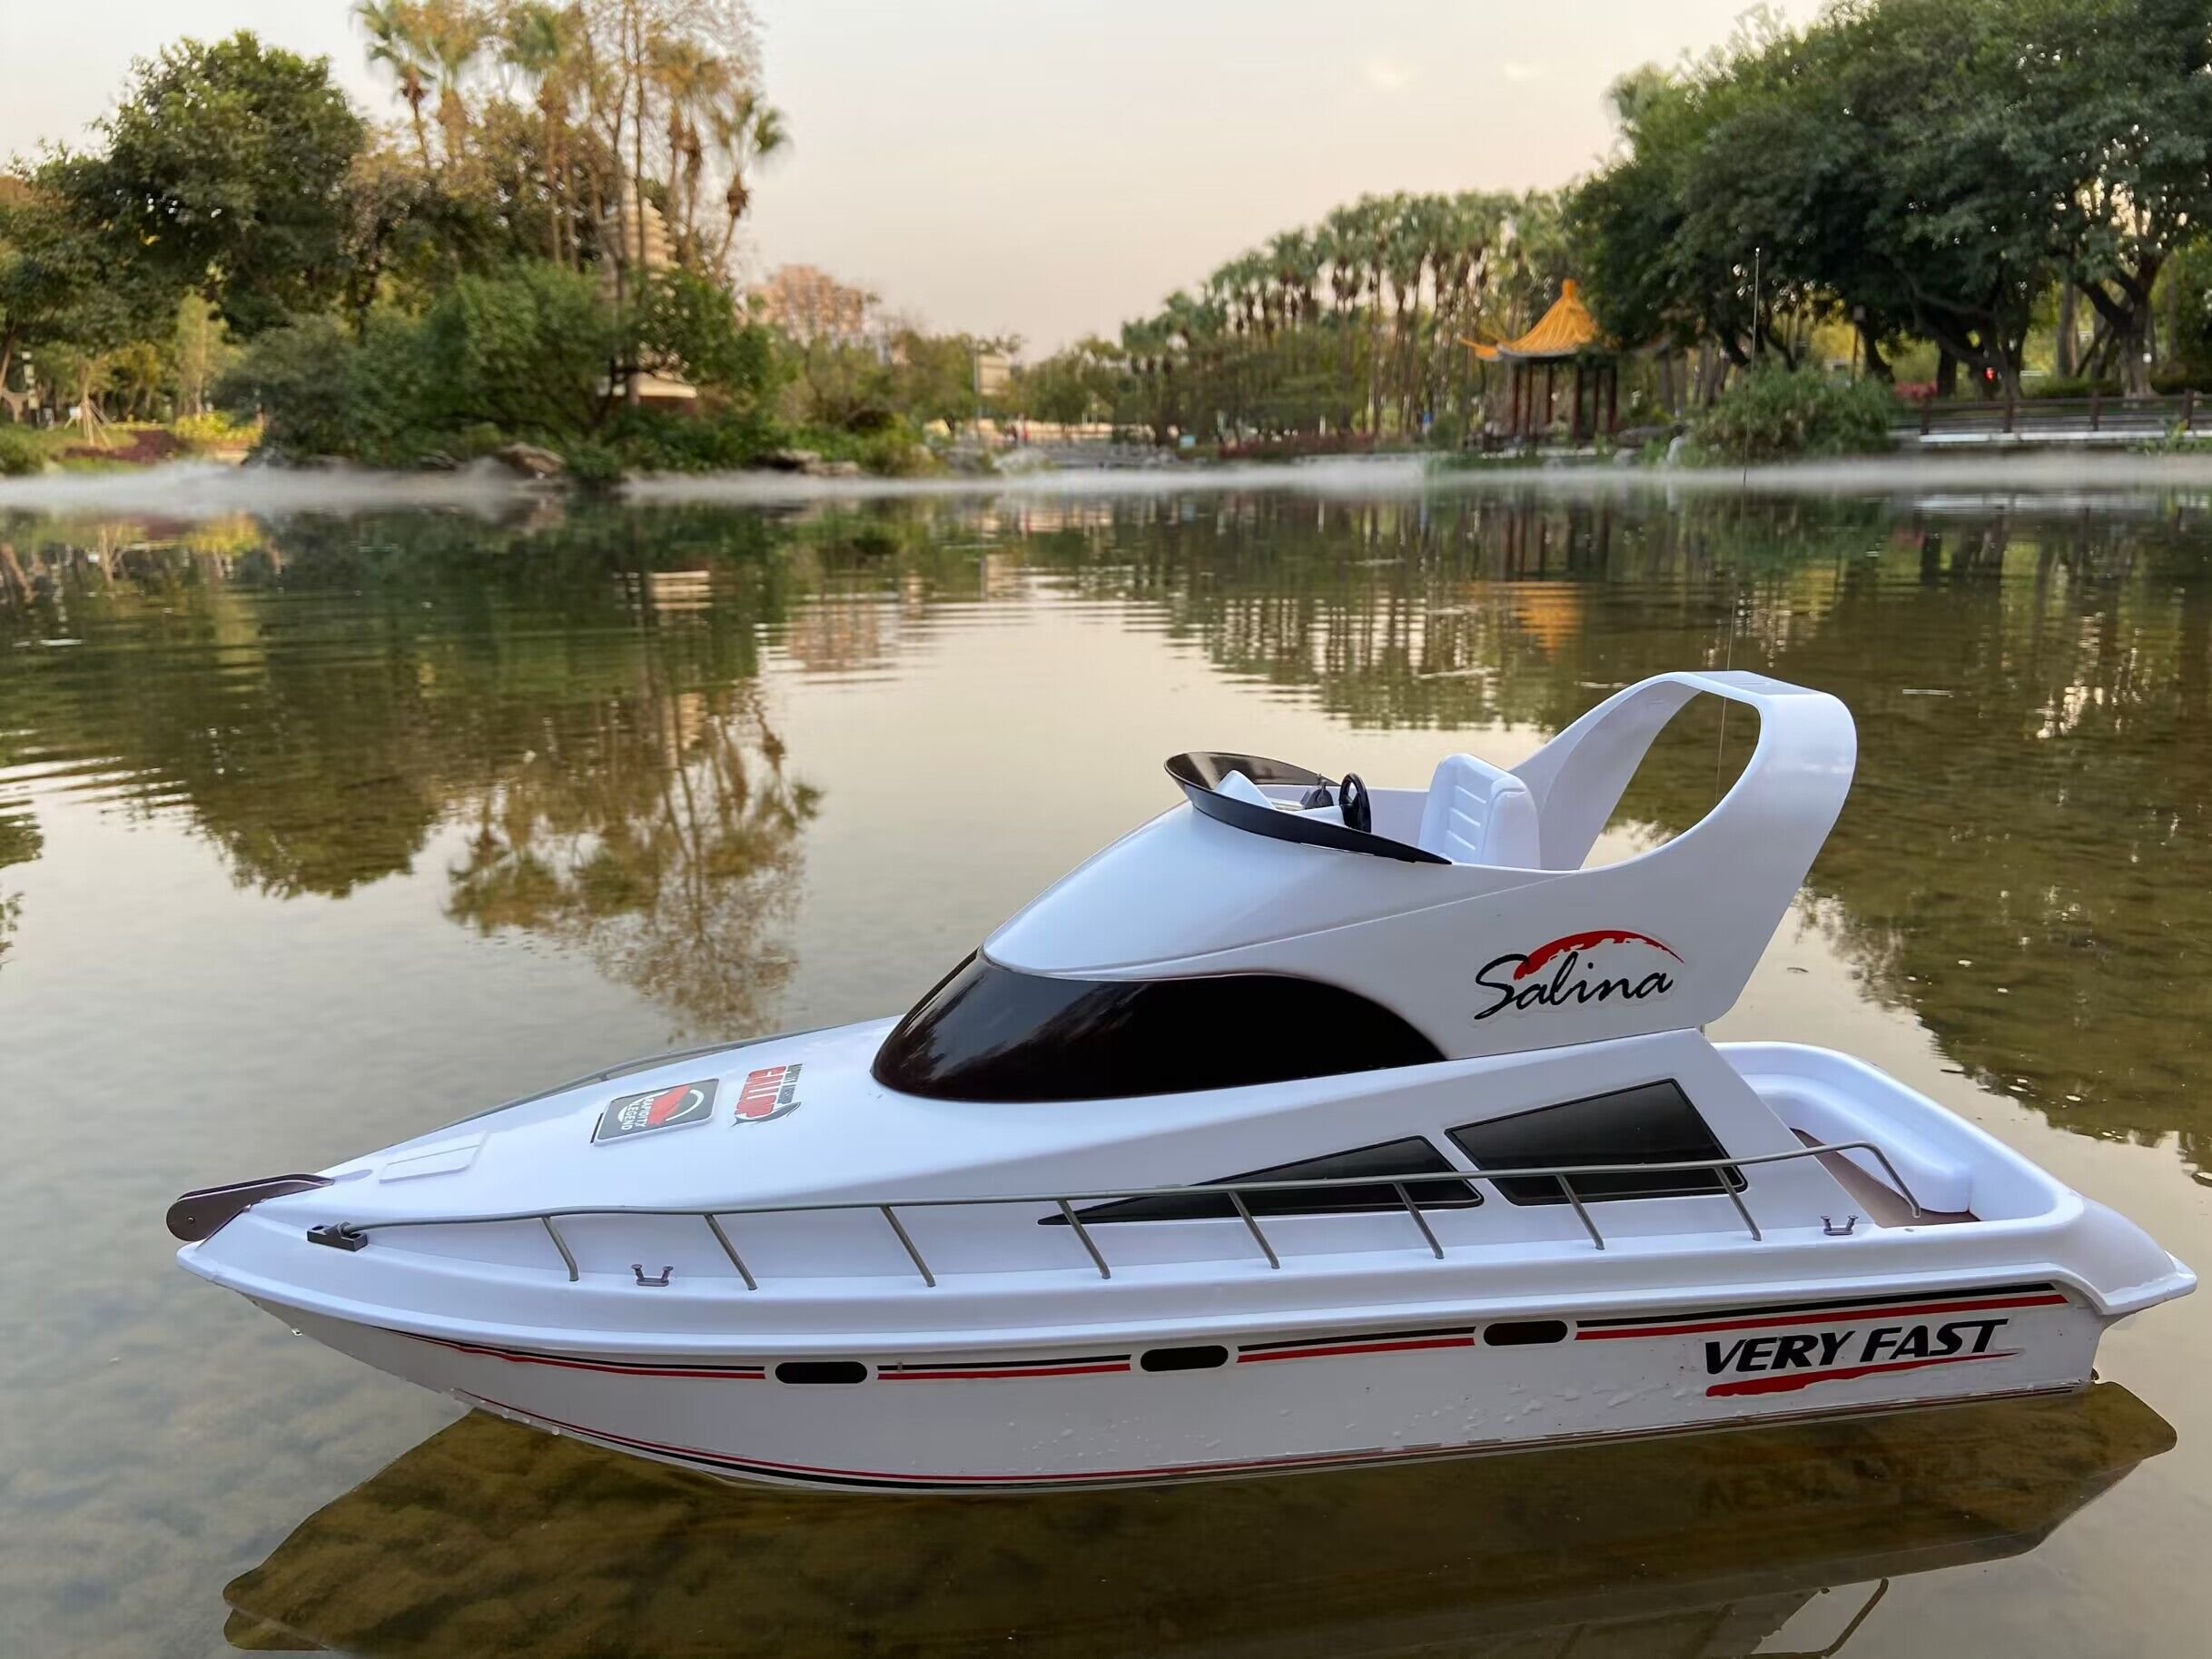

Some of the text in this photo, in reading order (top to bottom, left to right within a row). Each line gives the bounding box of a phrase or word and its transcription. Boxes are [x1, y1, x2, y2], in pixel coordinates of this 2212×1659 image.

[1474, 951, 1674, 1020] Salina
[621, 1102, 639, 1131] LEGEND
[635, 1098, 654, 1128] RAPIDITY
[1704, 1318, 2010, 1375] VERY FAST
